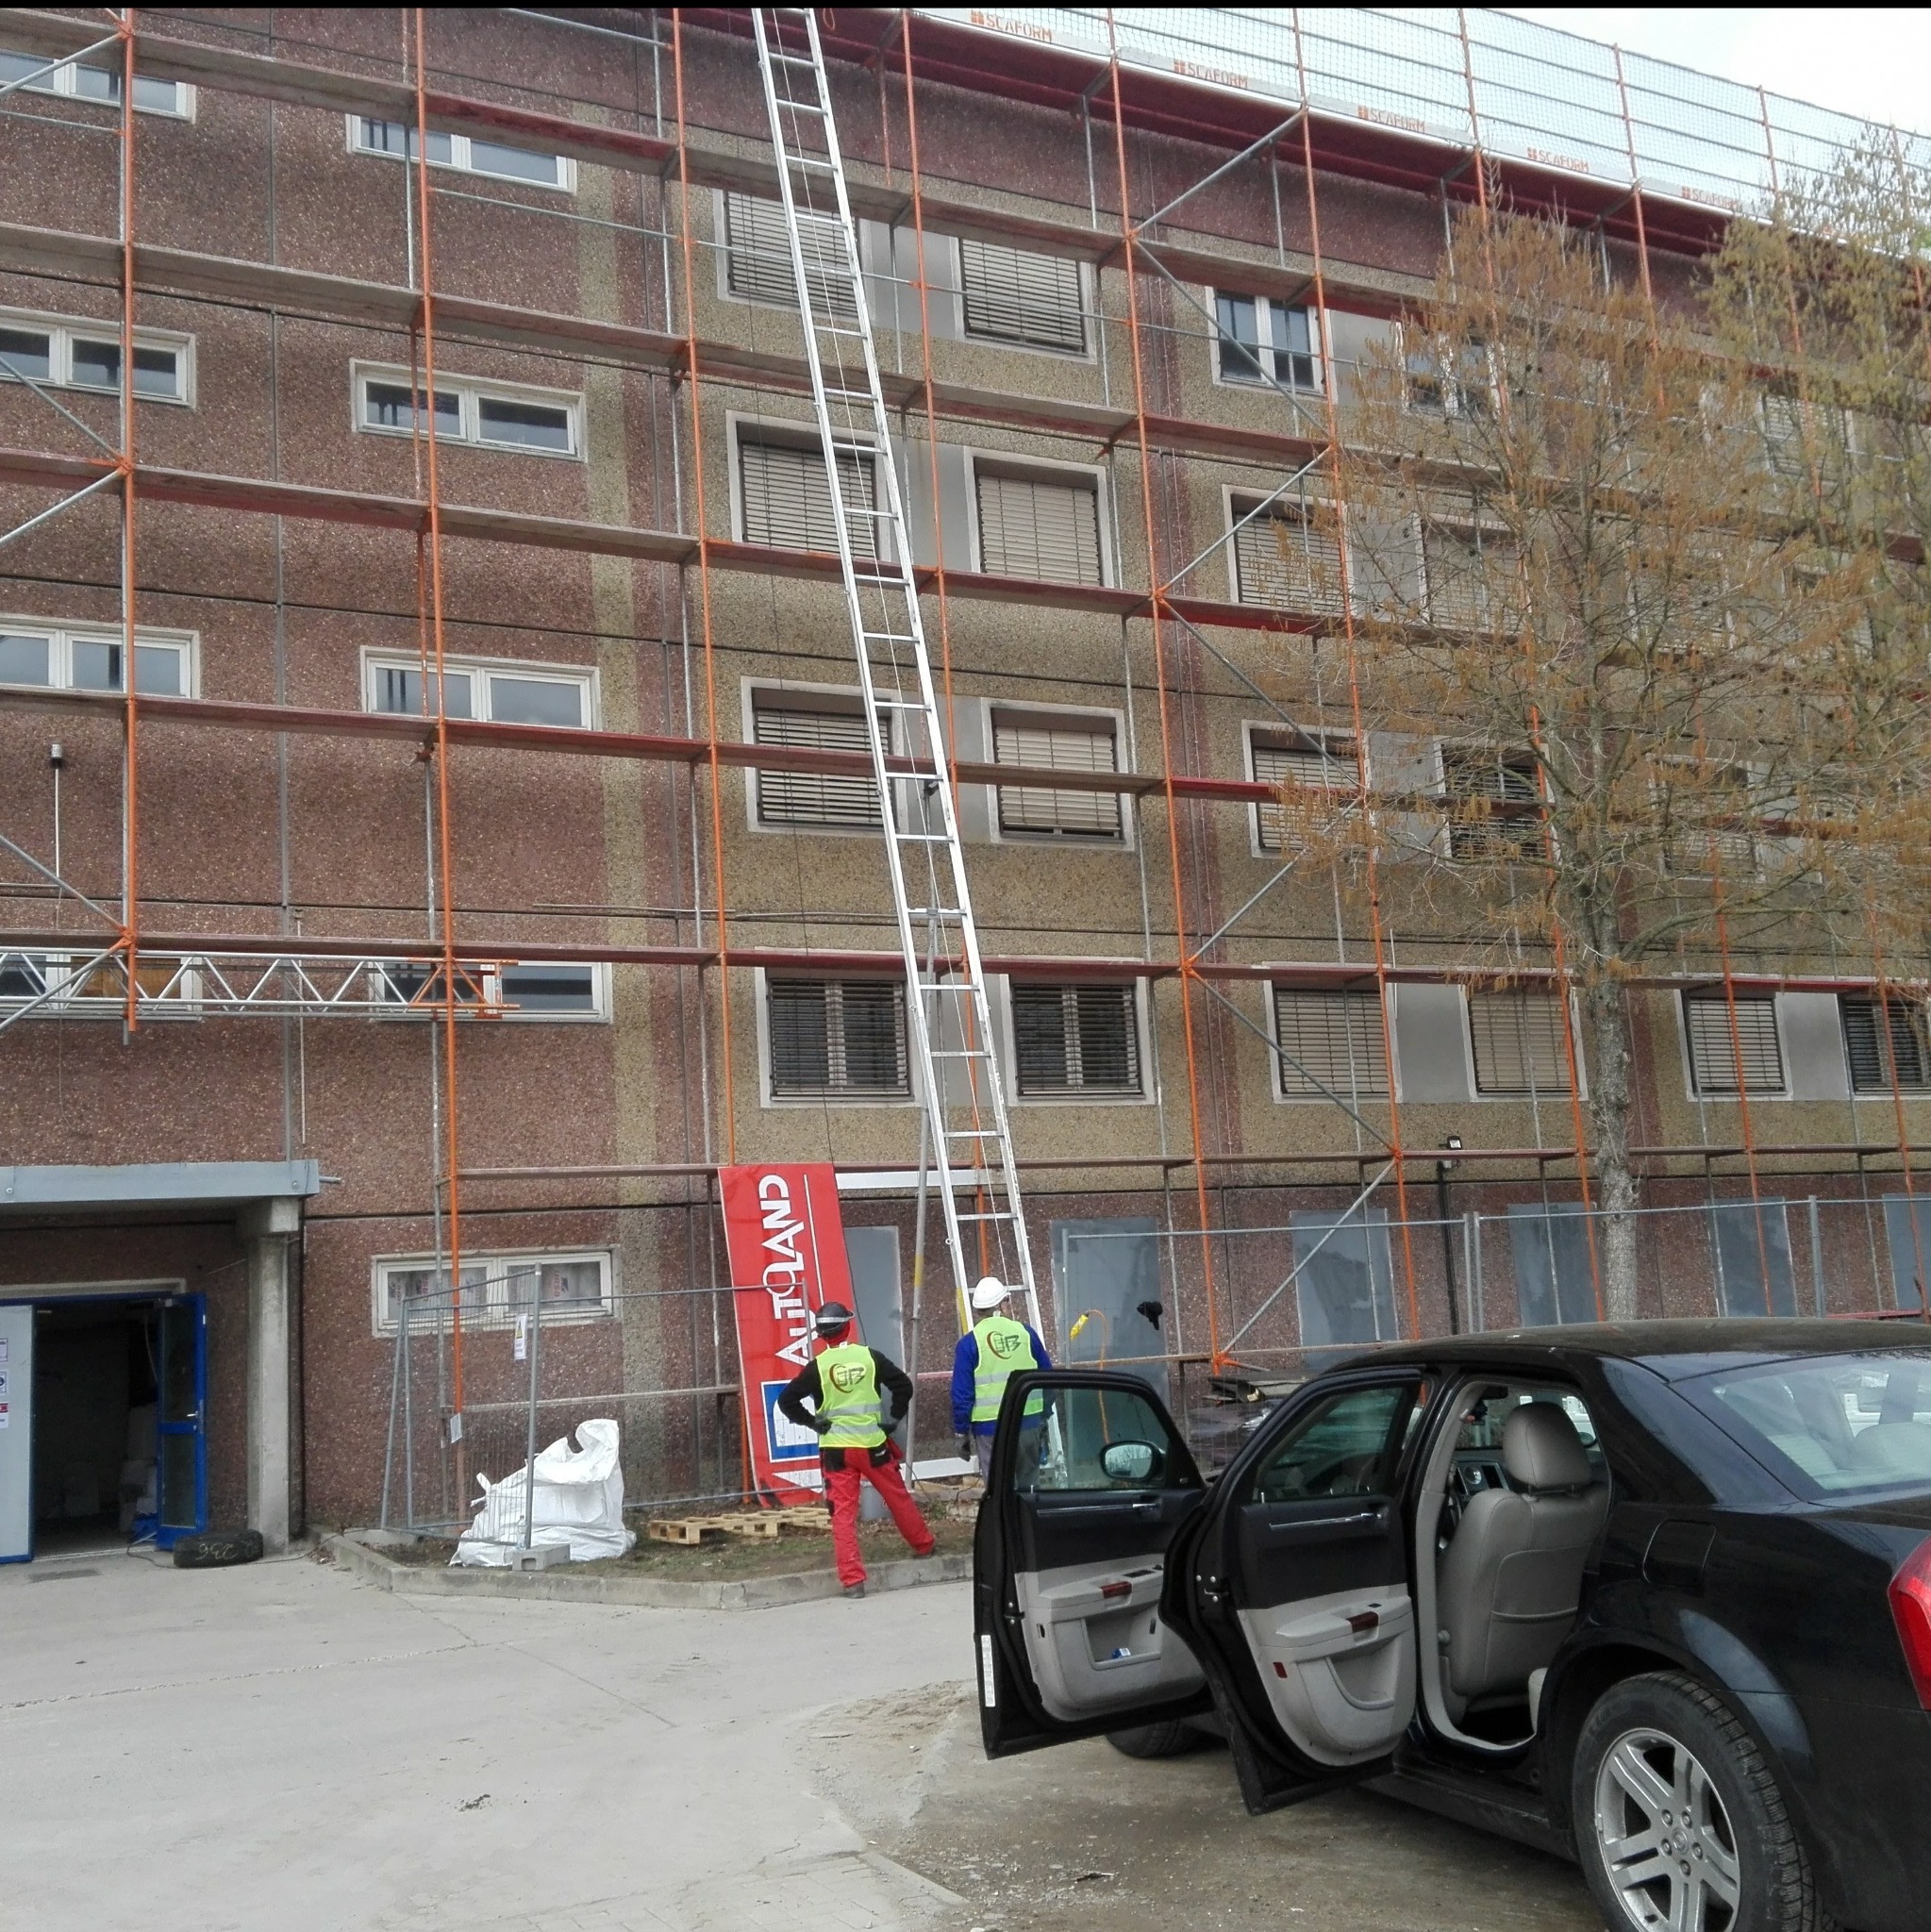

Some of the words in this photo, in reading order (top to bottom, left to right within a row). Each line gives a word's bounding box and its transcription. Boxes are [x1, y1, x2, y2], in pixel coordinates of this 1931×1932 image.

[986, 13, 1053, 44] SCAFORM
[1187, 61, 1248, 89] SCAFORM
[1370, 107, 1425, 134] SCAFORM
[1539, 149, 1590, 174] SCAFORM
[757, 1174, 820, 1368] AUTOLAND
